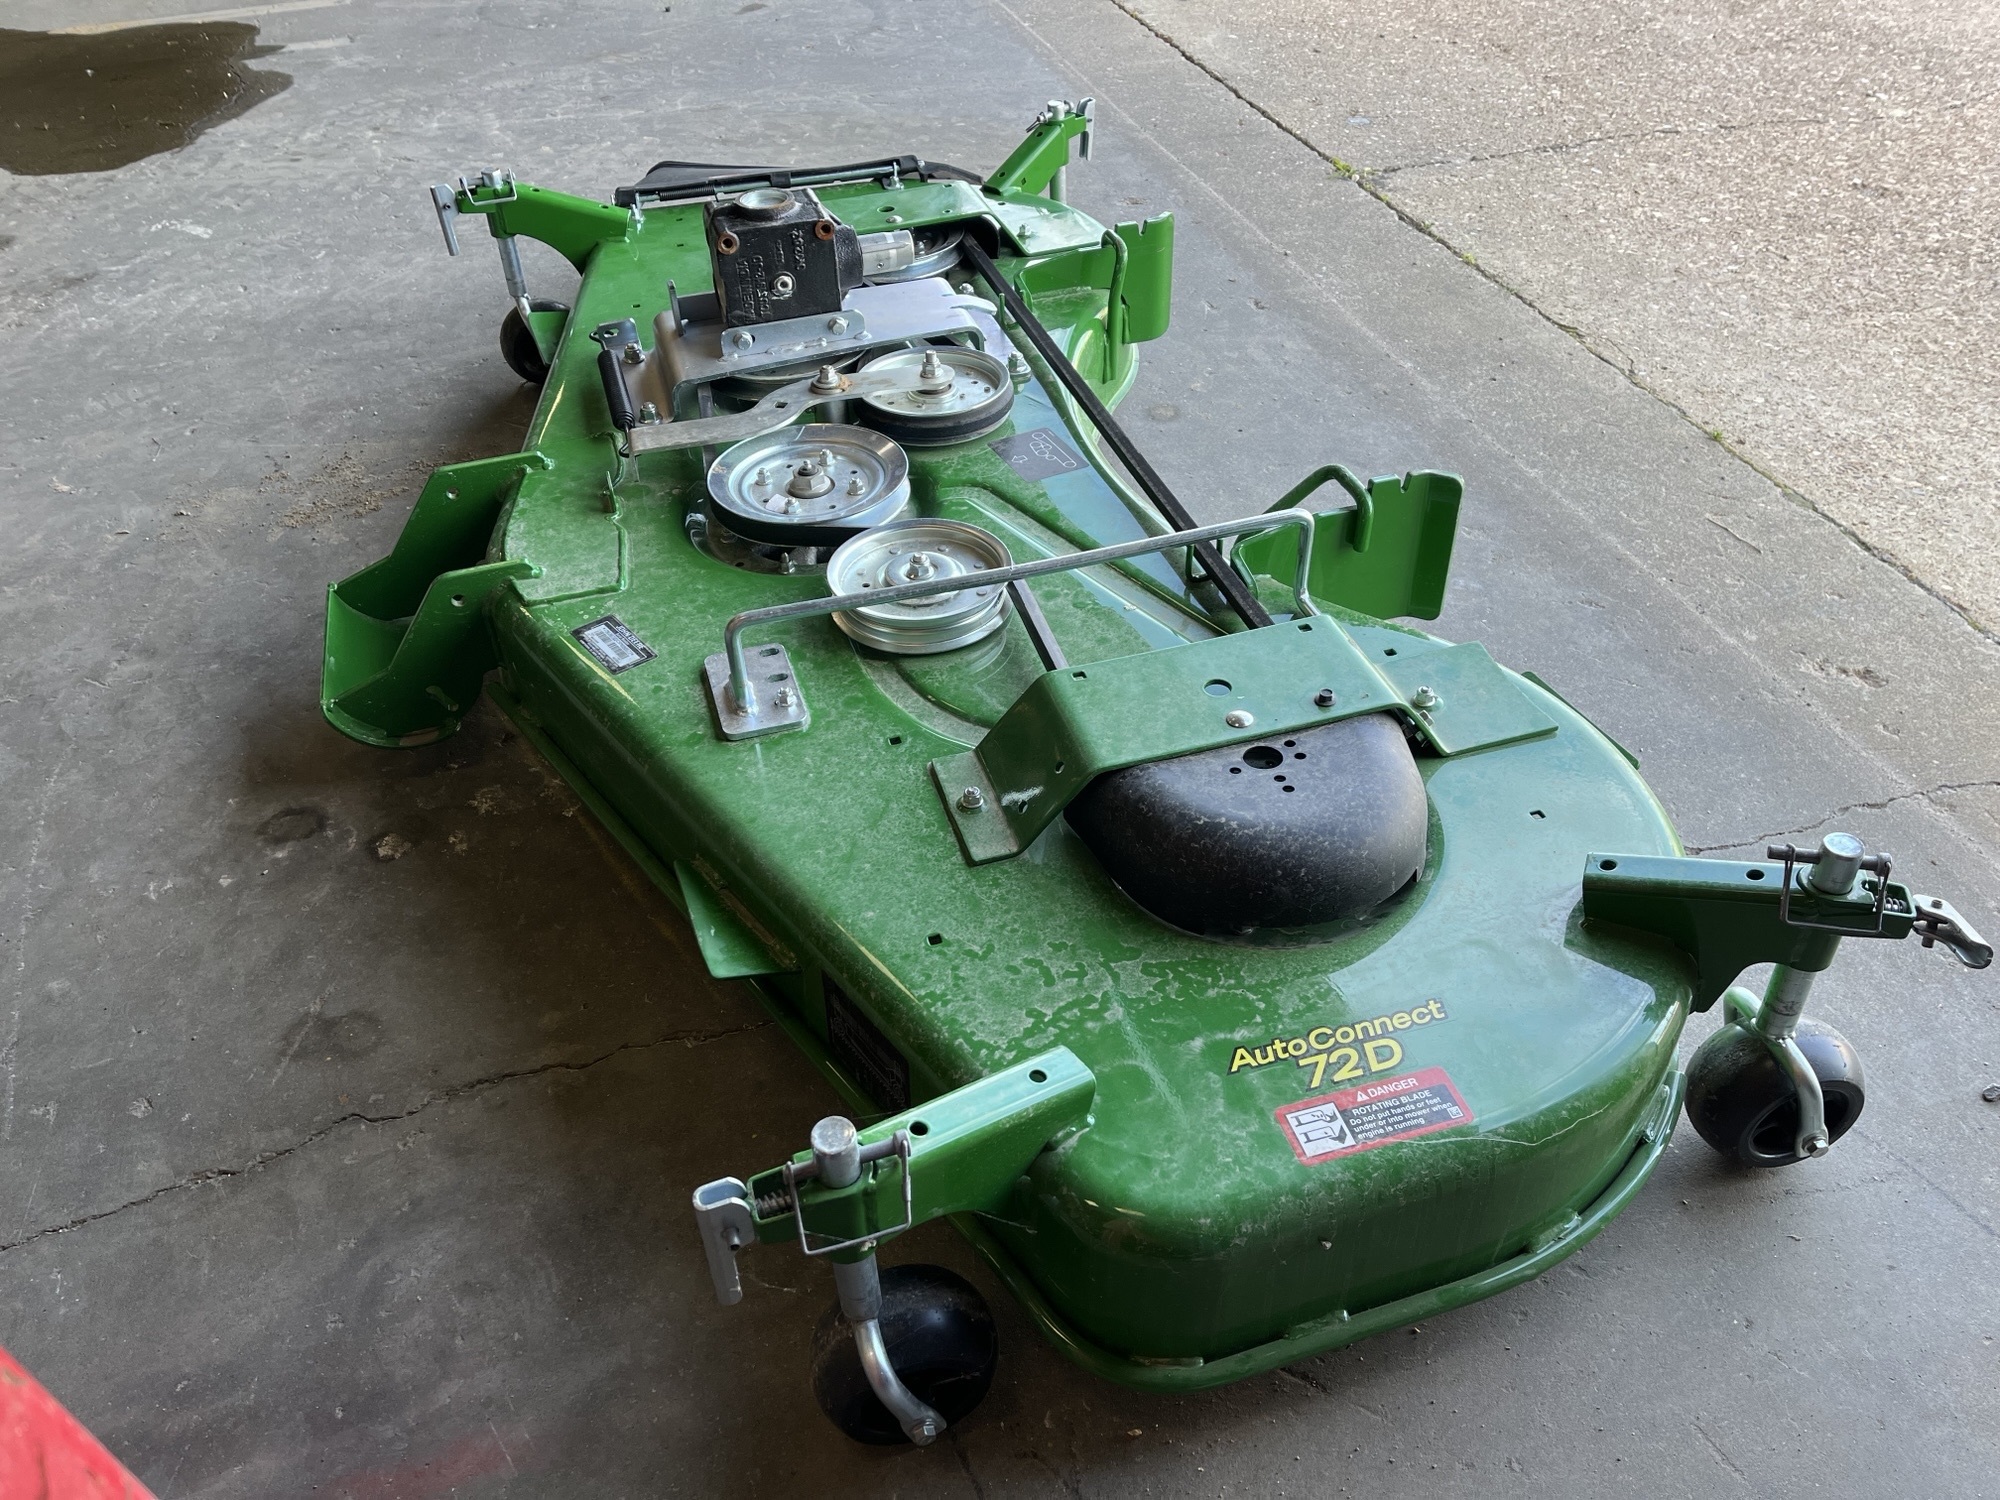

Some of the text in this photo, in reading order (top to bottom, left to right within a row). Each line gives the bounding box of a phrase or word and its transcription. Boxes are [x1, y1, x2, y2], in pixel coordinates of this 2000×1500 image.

[1230, 999, 1446, 1073] AutoConnect
[1298, 1038, 1403, 1089] 72D
[1367, 1077, 1419, 1098] DANGER
[1349, 1096, 1442, 1126] Do not put hands or feet
[1352, 1089, 1433, 1117] ROTATING BLADE
[1353, 1102, 1453, 1133] under or into mower when
[1357, 1117, 1426, 1140] engine is running
